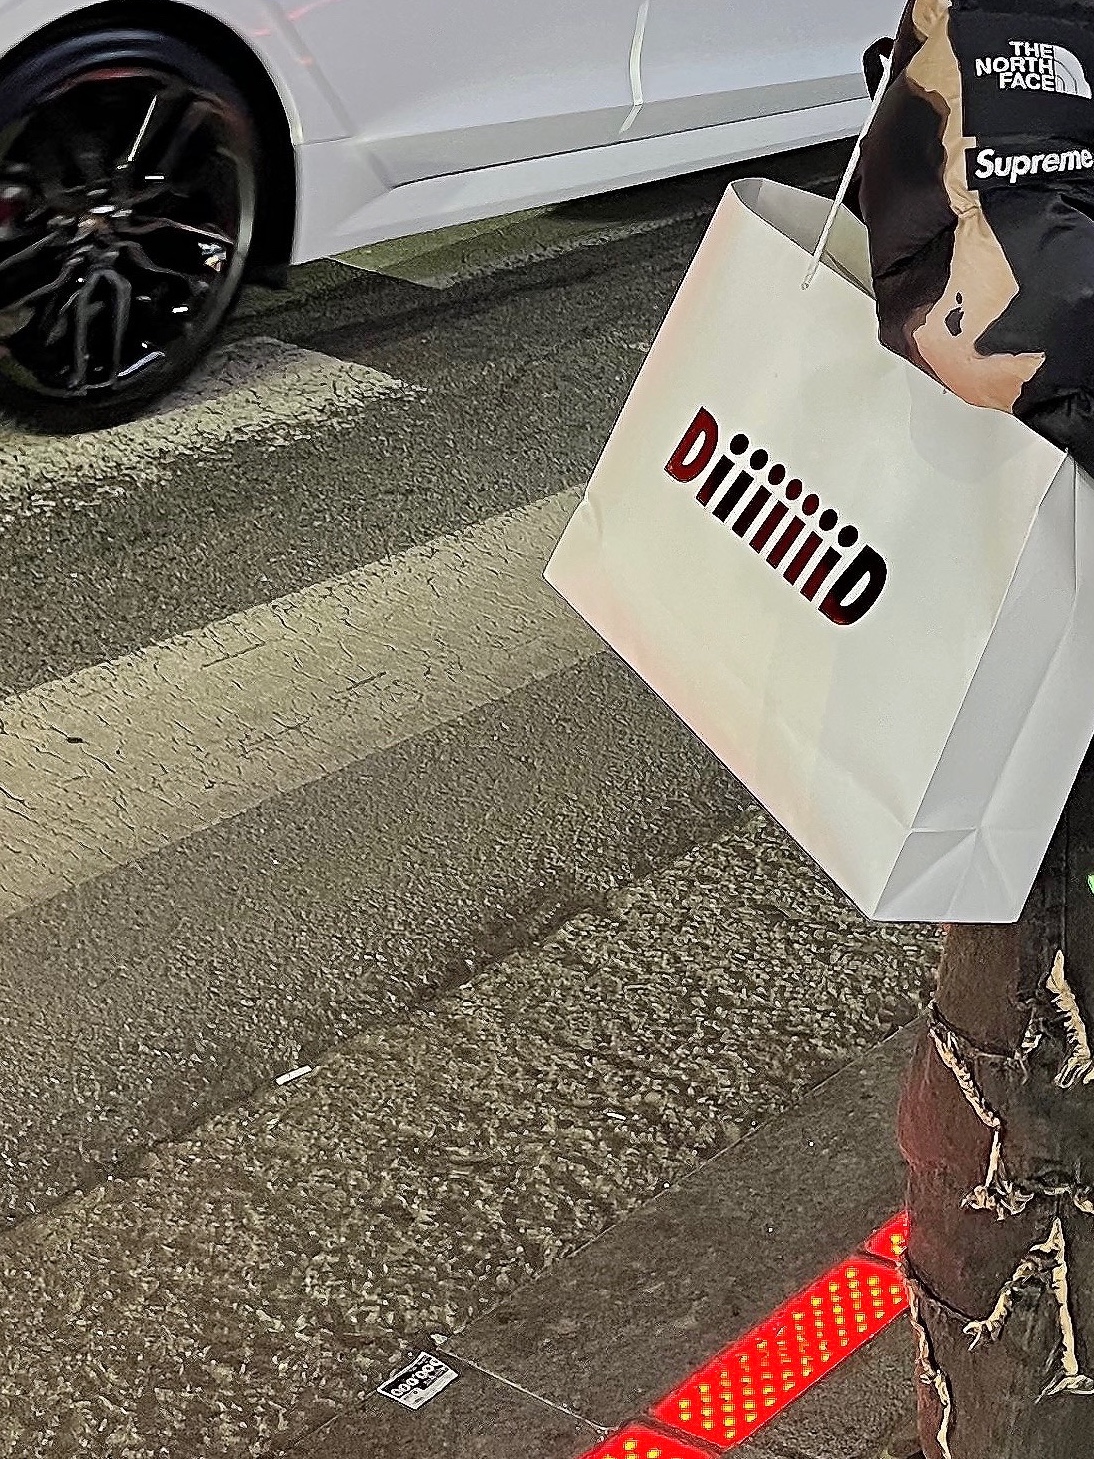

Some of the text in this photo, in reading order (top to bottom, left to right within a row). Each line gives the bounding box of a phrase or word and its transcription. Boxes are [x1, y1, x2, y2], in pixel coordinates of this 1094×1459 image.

[1008, 41, 1054, 59] THE
[974, 57, 1055, 77] NORTH
[999, 72, 1055, 91] FACE
[974, 148, 1094, 184] Supreme
[663, 405, 888, 626] DiiiiiiiD
